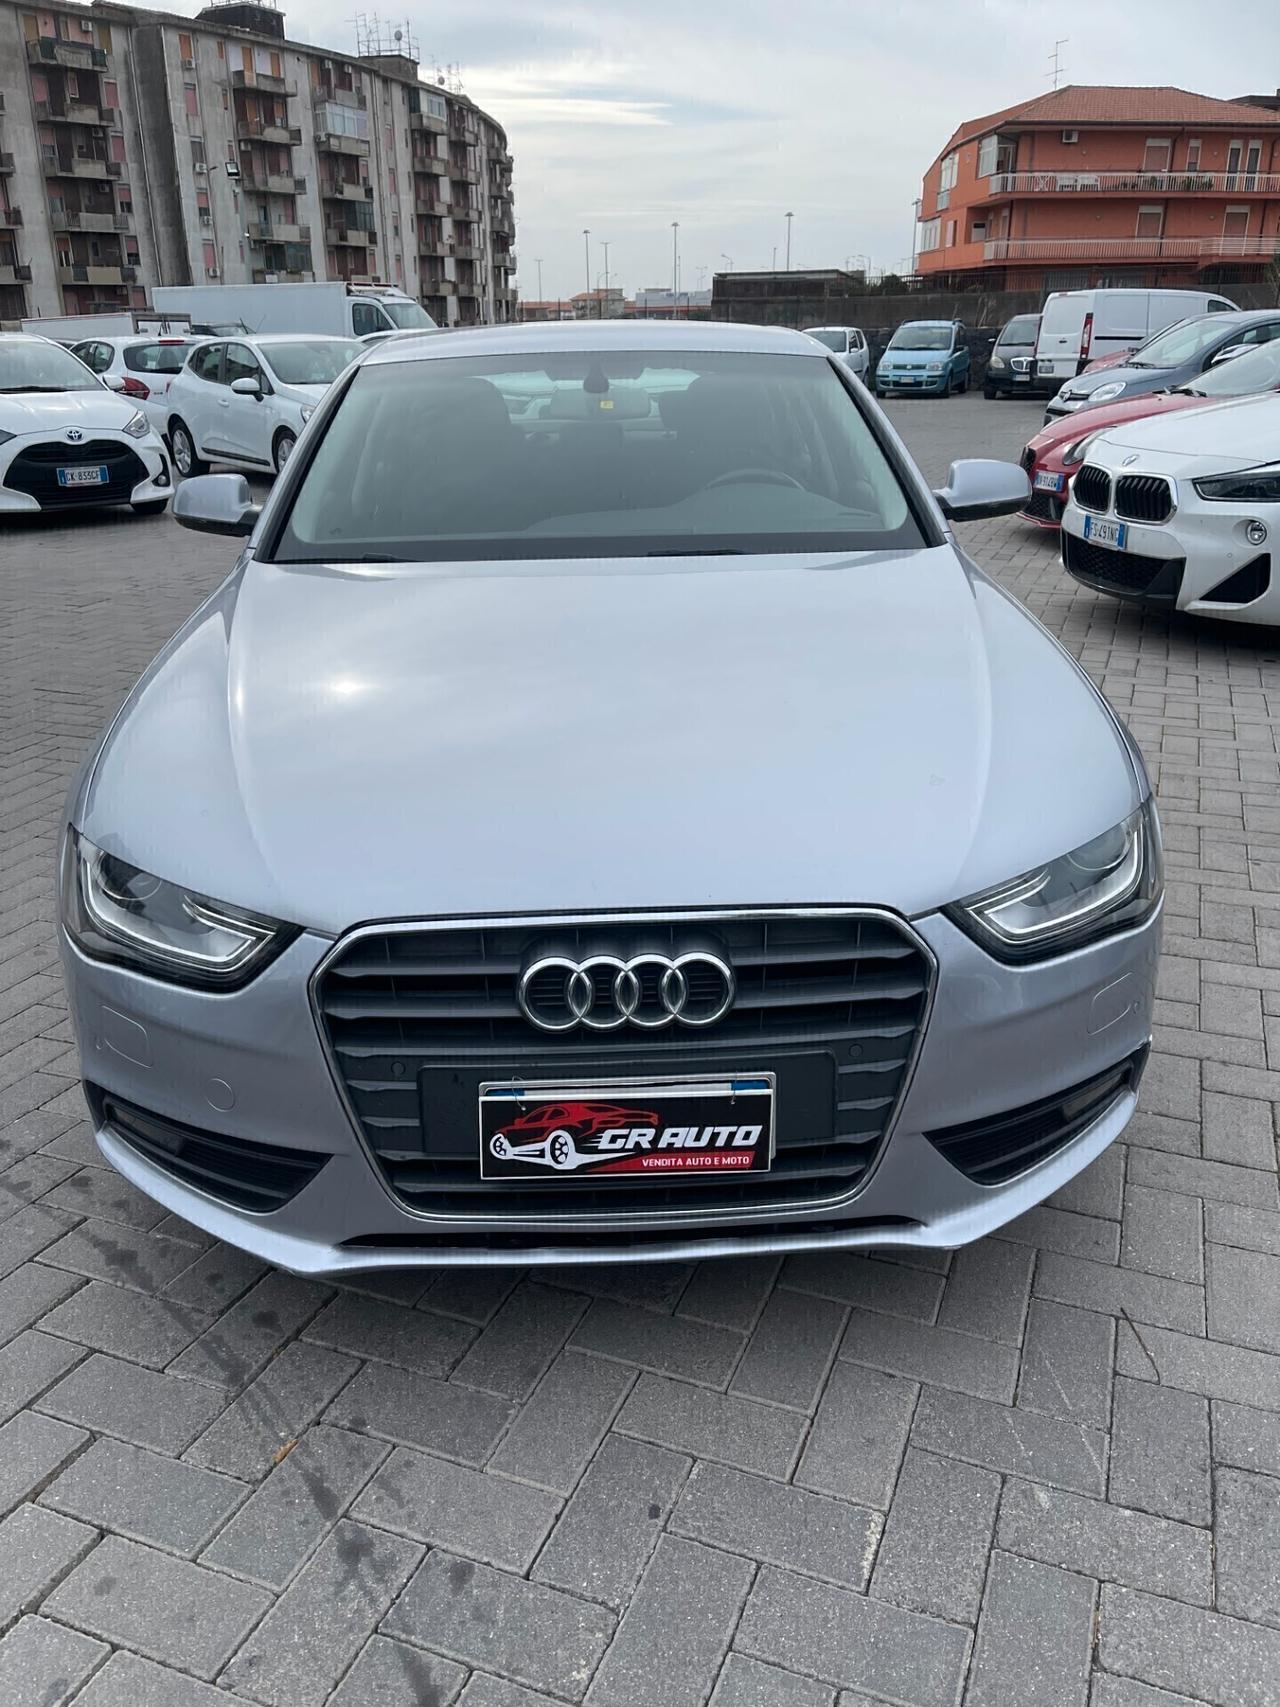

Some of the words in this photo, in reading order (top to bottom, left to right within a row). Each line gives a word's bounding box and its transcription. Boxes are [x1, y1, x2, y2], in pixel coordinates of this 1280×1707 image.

[598, 1128, 656, 1150] GR
[657, 1125, 763, 1148] AUTO
[642, 1157, 683, 1167] VENDITA
[685, 1157, 712, 1166] AUTO
[714, 1156, 719, 1165] E
[722, 1156, 750, 1165] MOTO
